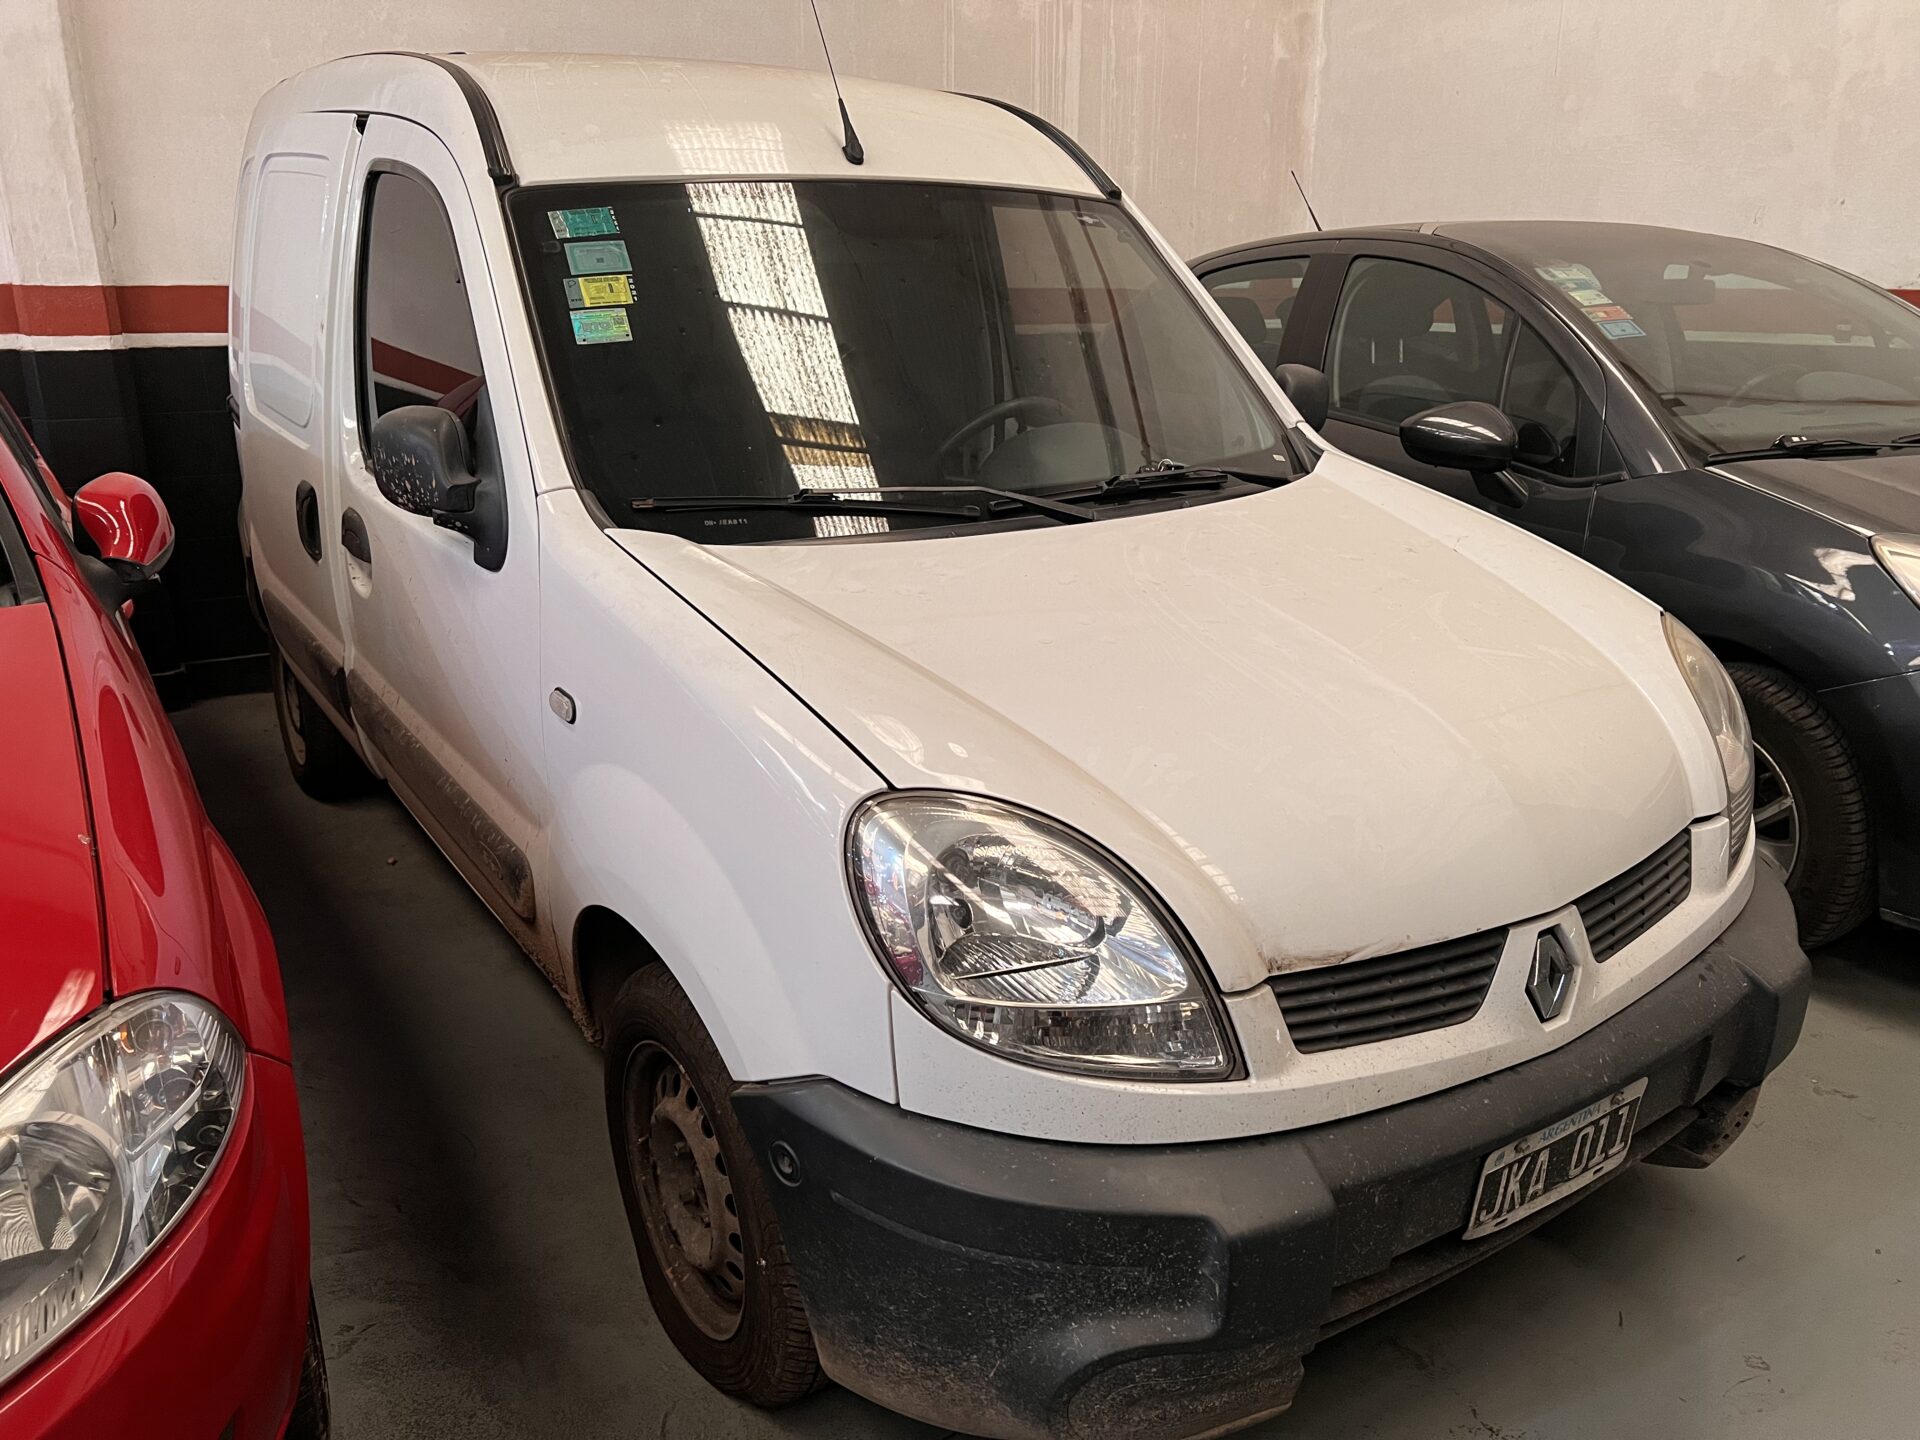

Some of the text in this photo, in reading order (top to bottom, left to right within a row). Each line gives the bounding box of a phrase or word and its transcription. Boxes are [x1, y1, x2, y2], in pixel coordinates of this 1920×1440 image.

[1540, 1103, 1601, 1142] ARGENTINA
[1479, 1105, 1630, 1222] JKA 011
